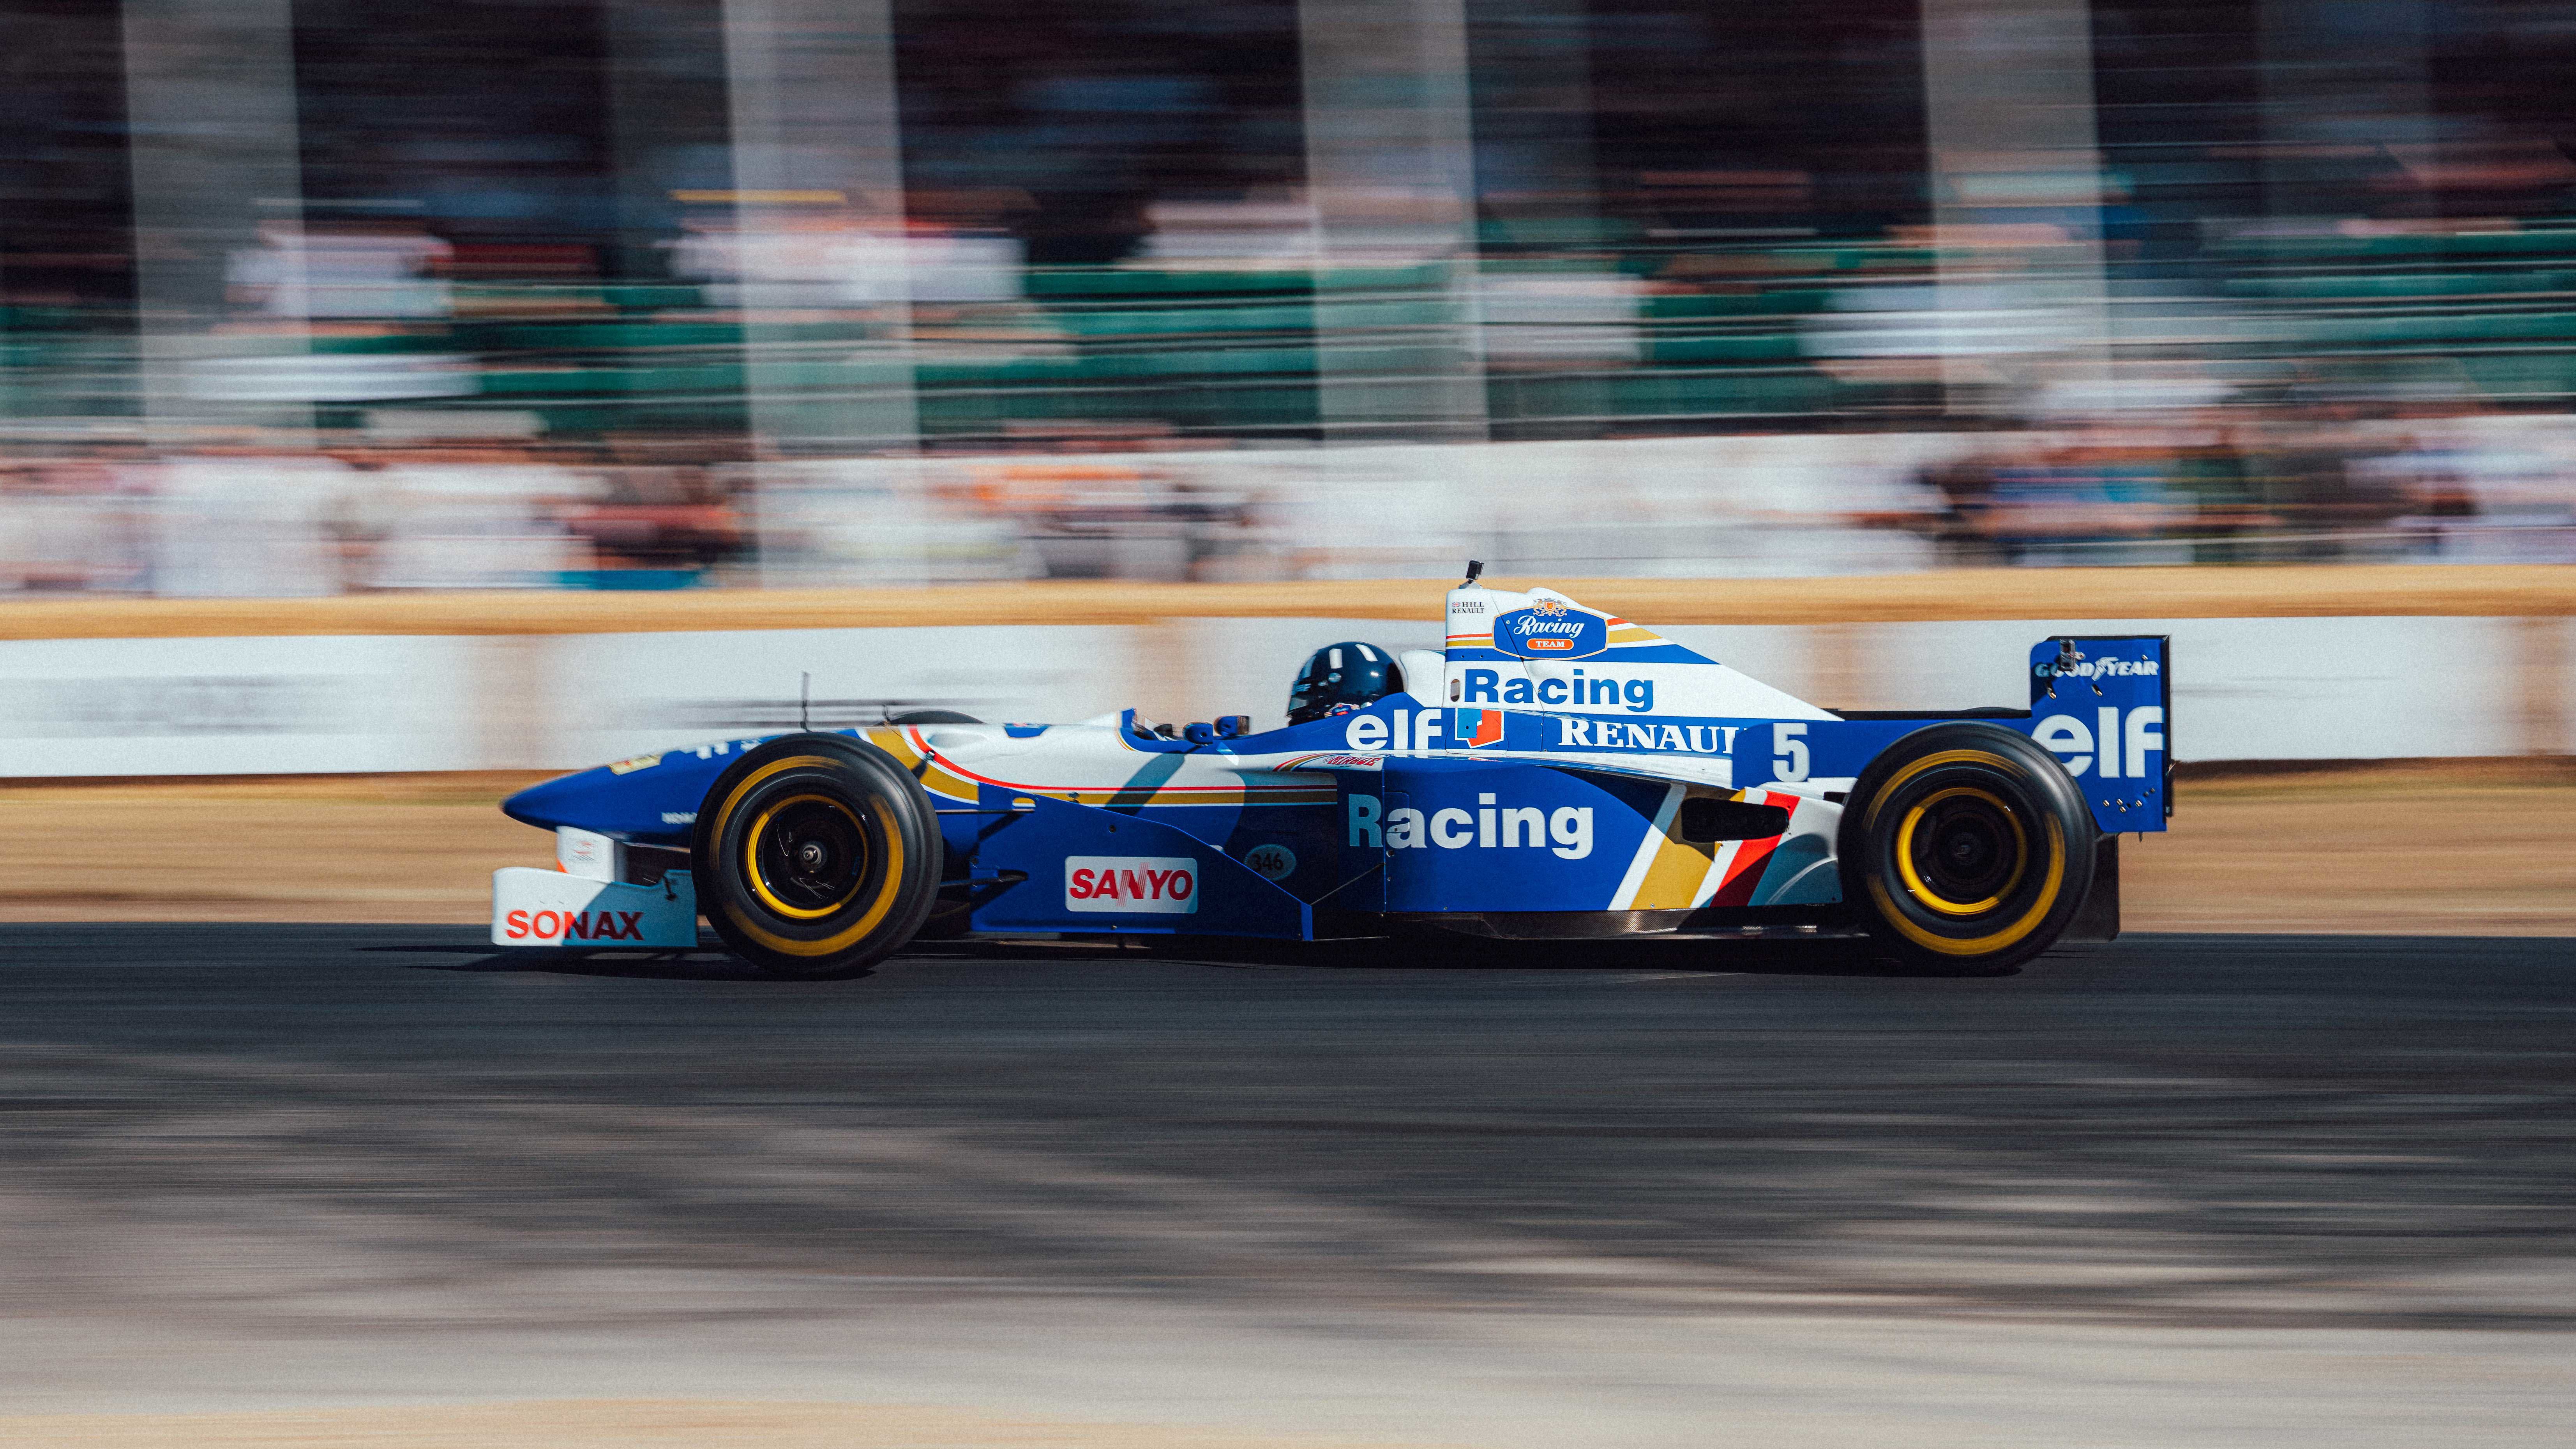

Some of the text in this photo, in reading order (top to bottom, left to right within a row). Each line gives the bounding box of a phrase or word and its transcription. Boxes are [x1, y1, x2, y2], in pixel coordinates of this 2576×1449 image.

[1513, 615, 1585, 638] Racing
[1465, 669, 1653, 712] Racing
[1346, 709, 1442, 750] elf
[1558, 717, 1748, 754] RENAUL
[2031, 706, 2163, 778] elf
[1327, 756, 1382, 766] MIRAGE
[1773, 723, 1810, 782] 5
[1349, 793, 1594, 860] Racing
[1252, 853, 1284, 871] 346
[1069, 862, 1194, 907] SANYO
[506, 910, 645, 940] SONAX
